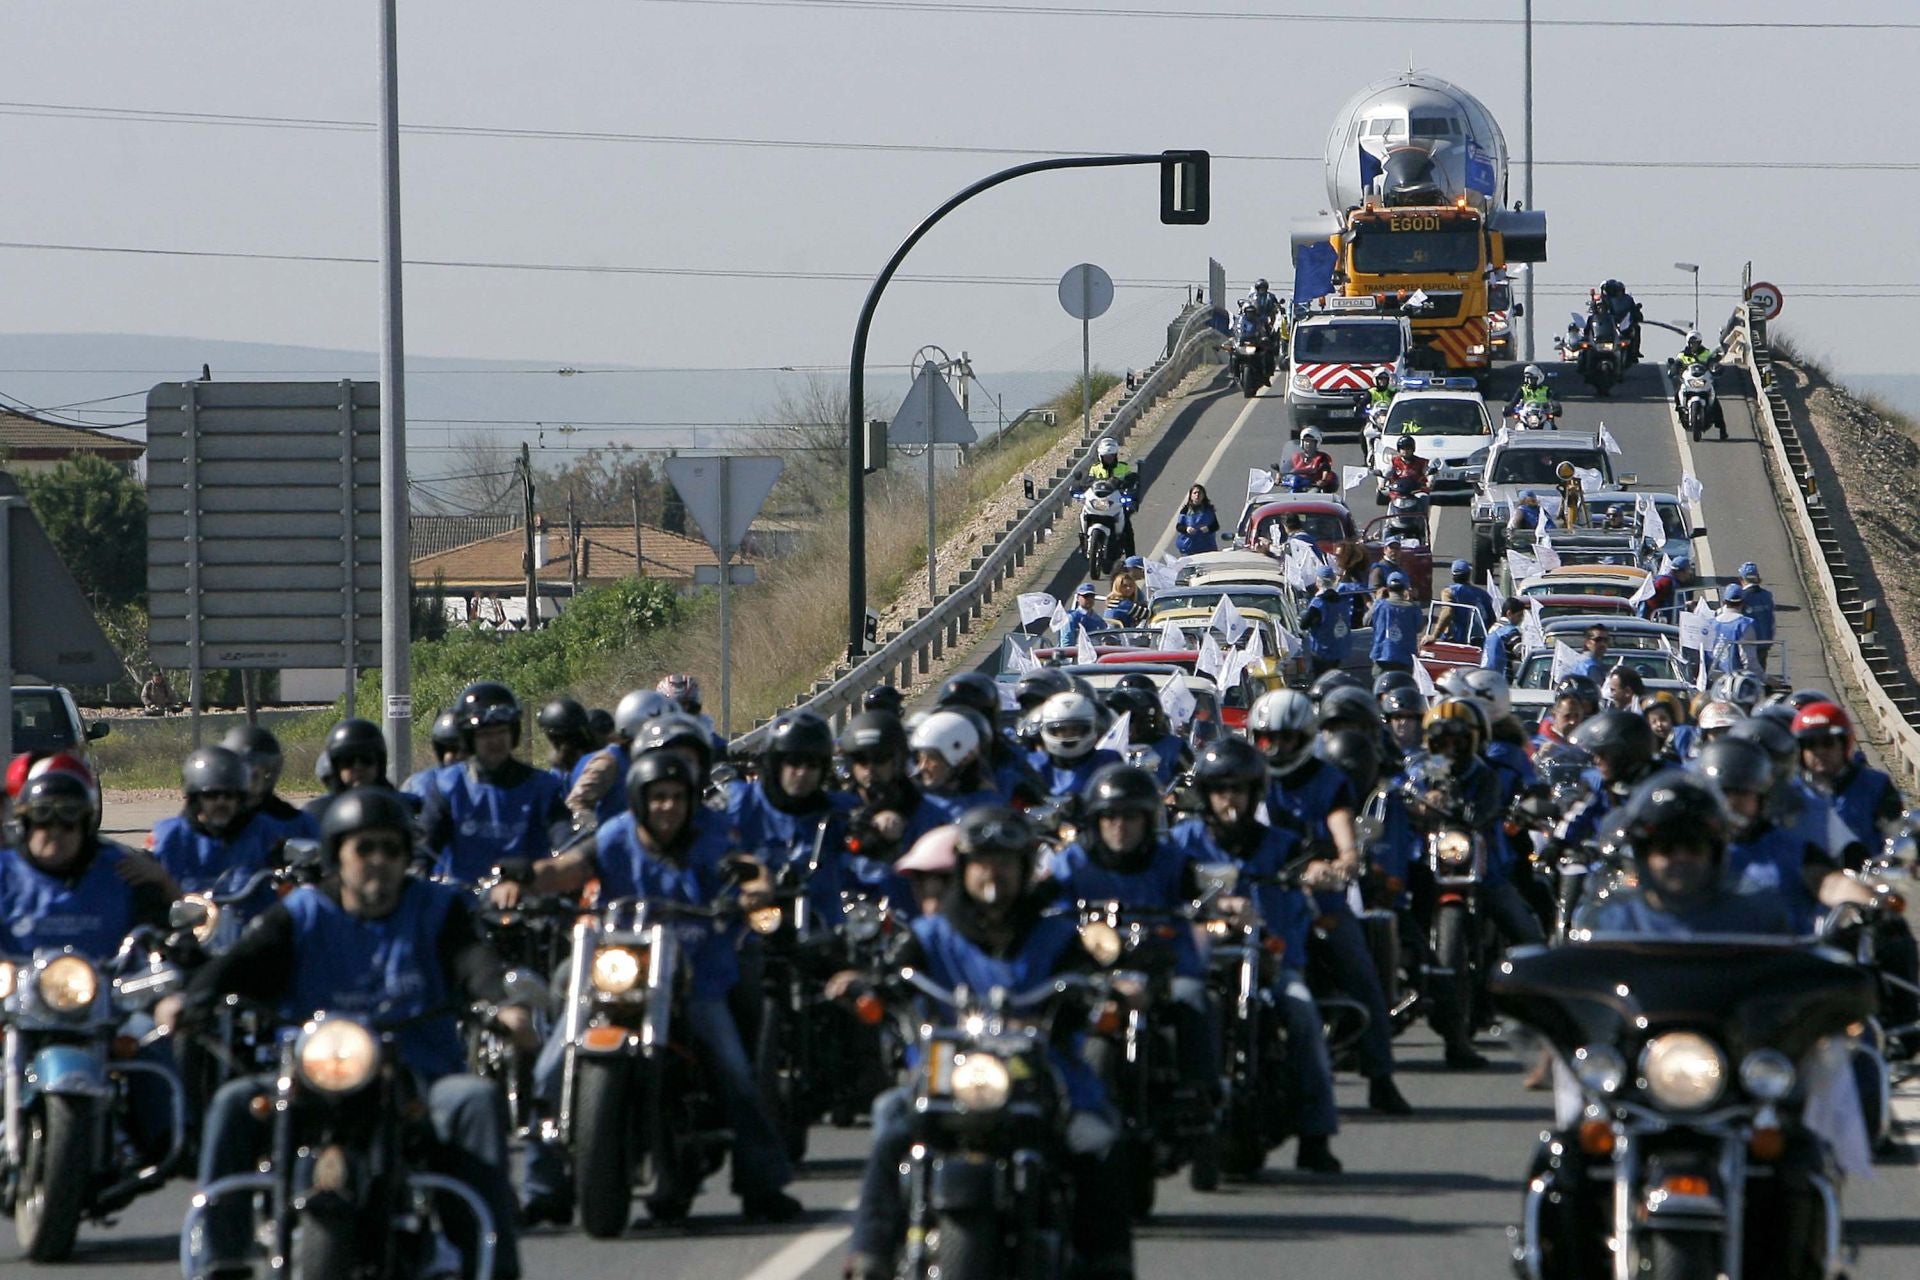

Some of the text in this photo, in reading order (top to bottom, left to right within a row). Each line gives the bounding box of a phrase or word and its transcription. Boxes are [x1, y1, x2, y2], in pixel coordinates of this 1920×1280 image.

[1390, 217, 1440, 231] EGODI
[1363, 282, 1470, 291] TRANSPORTES ESPECIALES
